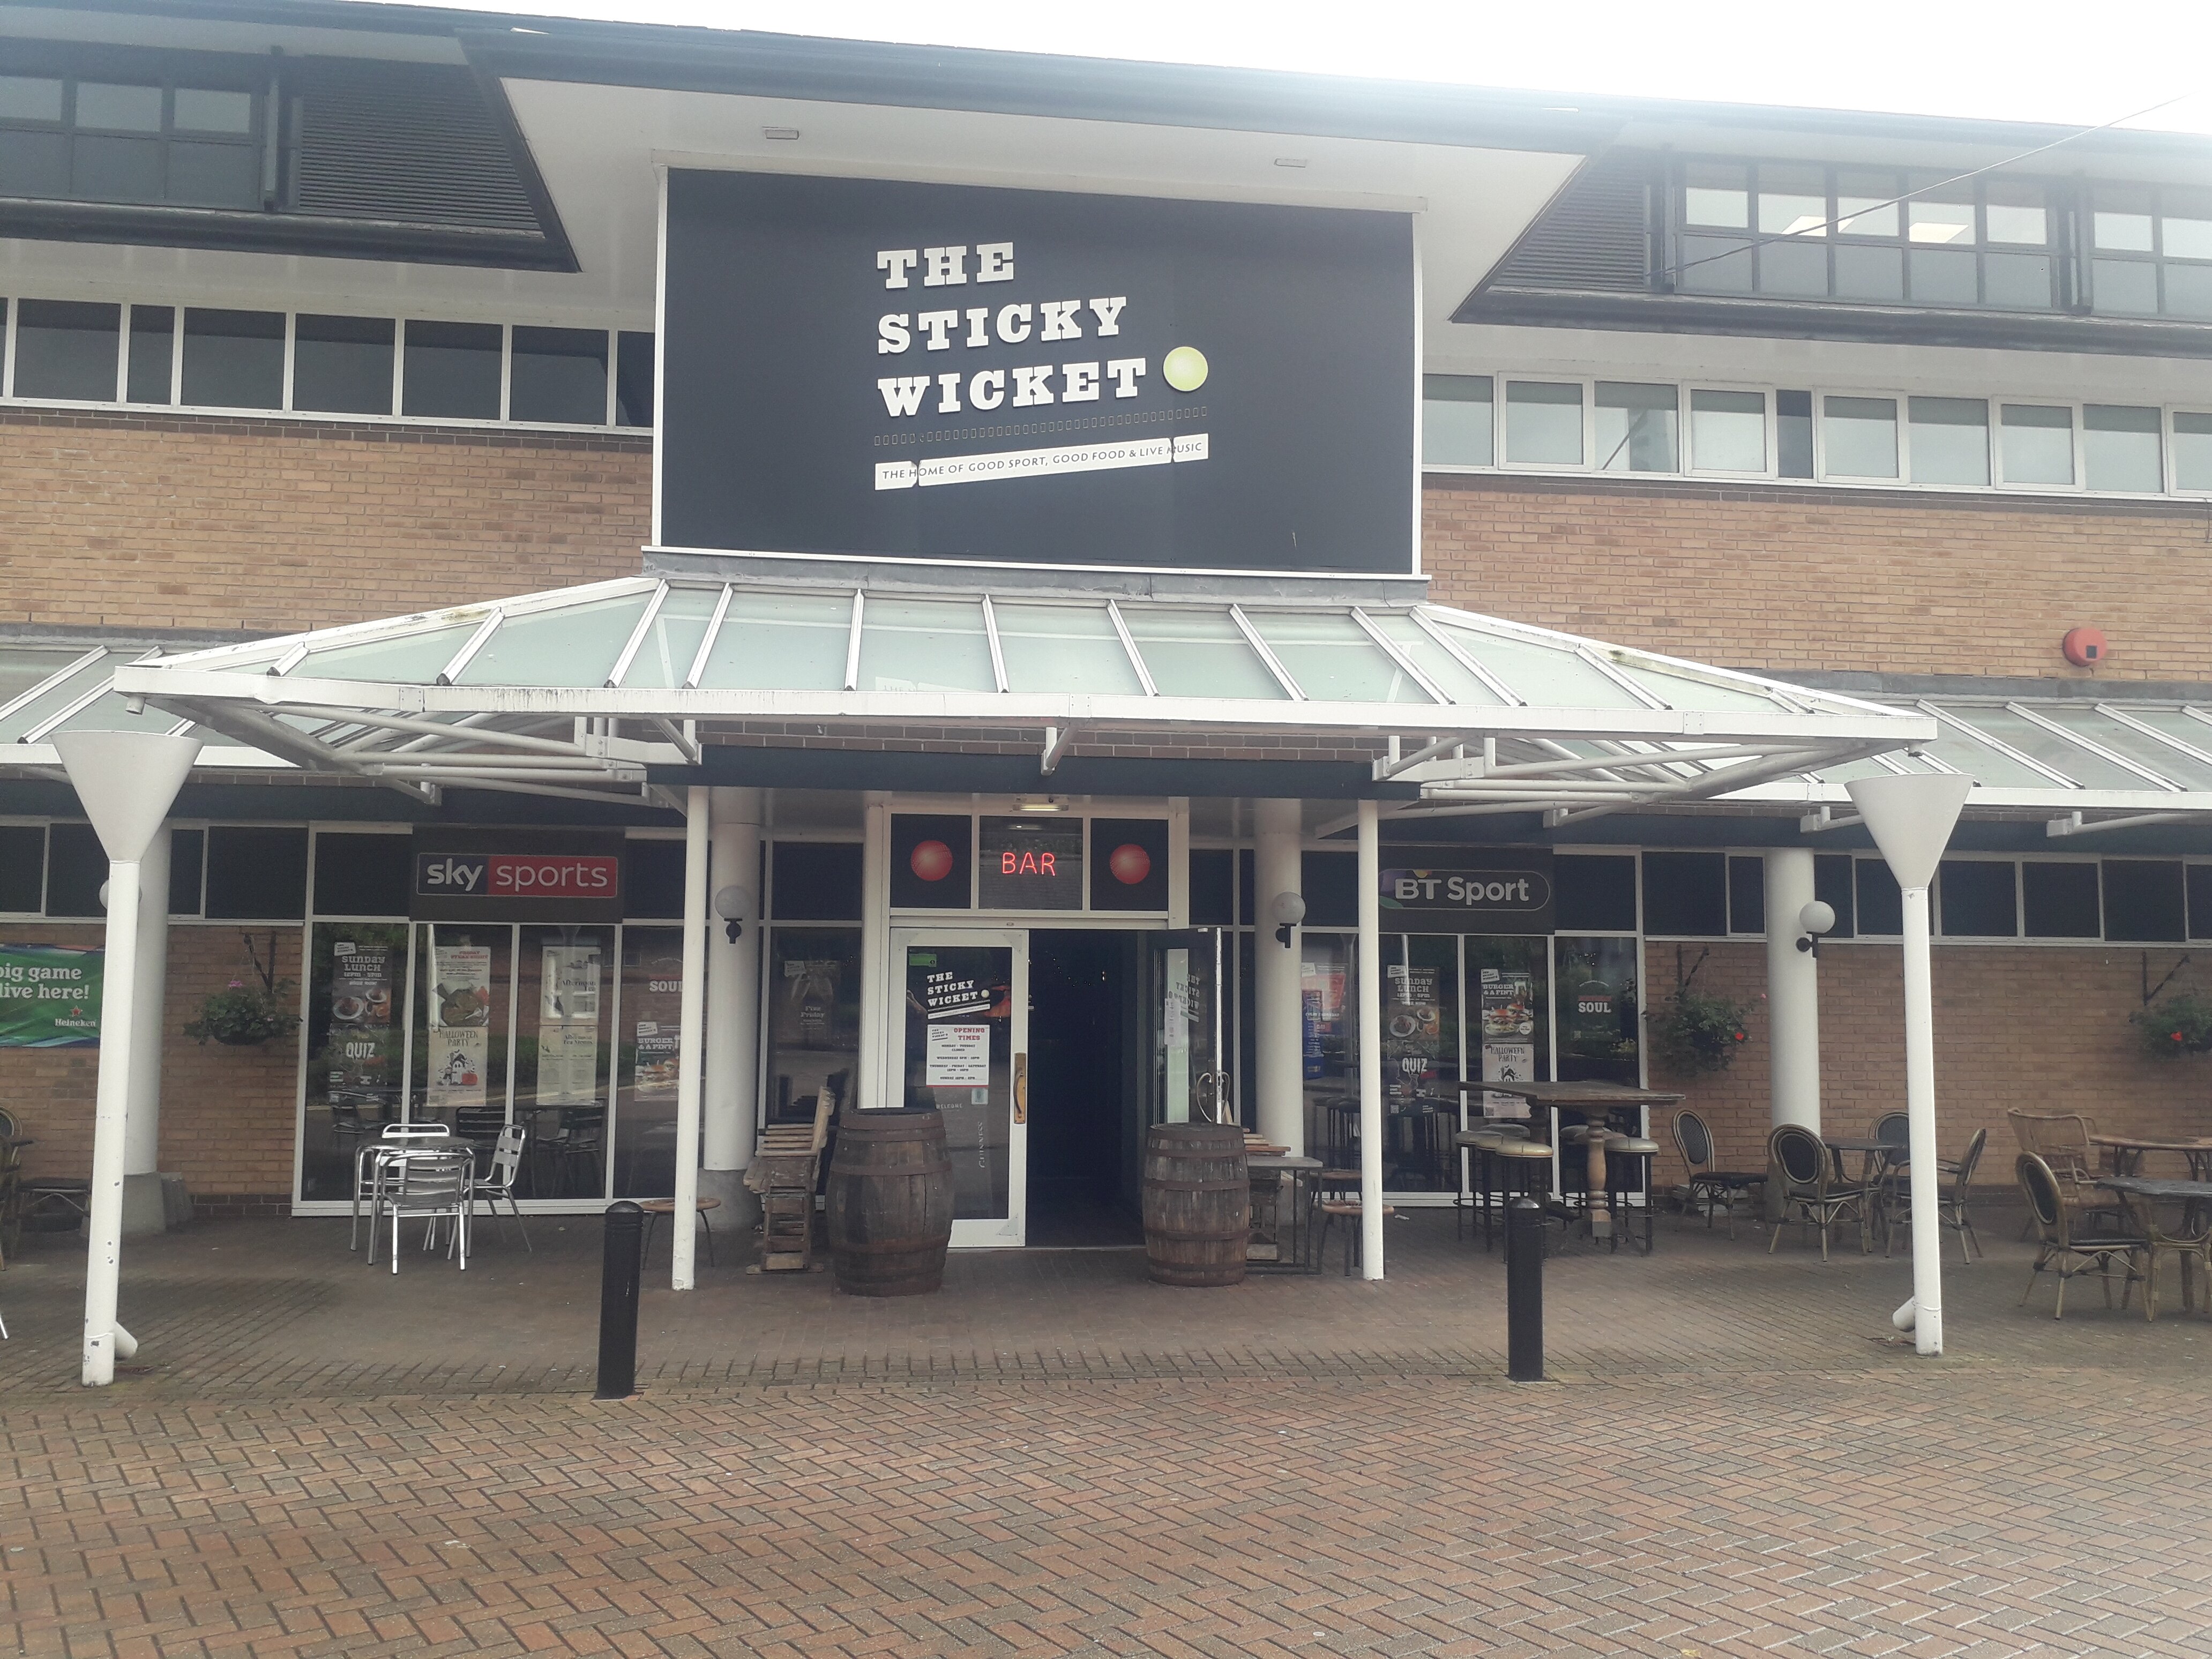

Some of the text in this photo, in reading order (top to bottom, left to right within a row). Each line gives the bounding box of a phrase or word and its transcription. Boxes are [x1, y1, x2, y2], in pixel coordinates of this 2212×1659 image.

[877, 242, 1014, 289] THE
[877, 296, 1127, 354] STICKY
[877, 357, 1146, 417] WICKET
[883, 469, 905, 480] THE
[909, 466, 944, 477] HOME
[948, 464, 963, 473] OF
[968, 460, 1005, 472] GOOD
[1008, 457, 1049, 469] SPORT,
[1053, 453, 1088, 464] GOOD
[1092, 450, 1125, 461] FOOD
[1129, 449, 1137, 457] &
[1140, 446, 1163, 457] LIVE
[1002, 851, 1056, 876] BAR
[427, 858, 609, 892] sky sports
[1395, 876, 1529, 906] BT Sport
[28, 966, 83, 983] game
[344, 963, 381, 972] LUNCH
[927, 972, 953, 983] THE
[37, 983, 90, 1000] here!
[928, 980, 974, 995] STICKY
[928, 991, 978, 1007] WICKET
[1578, 1001, 1612, 1013] SOUL
[55, 1018, 96, 1028] Heineken
[346, 1042, 375, 1059] QUIZ
[1402, 1057, 1428, 1074] QUIZ
